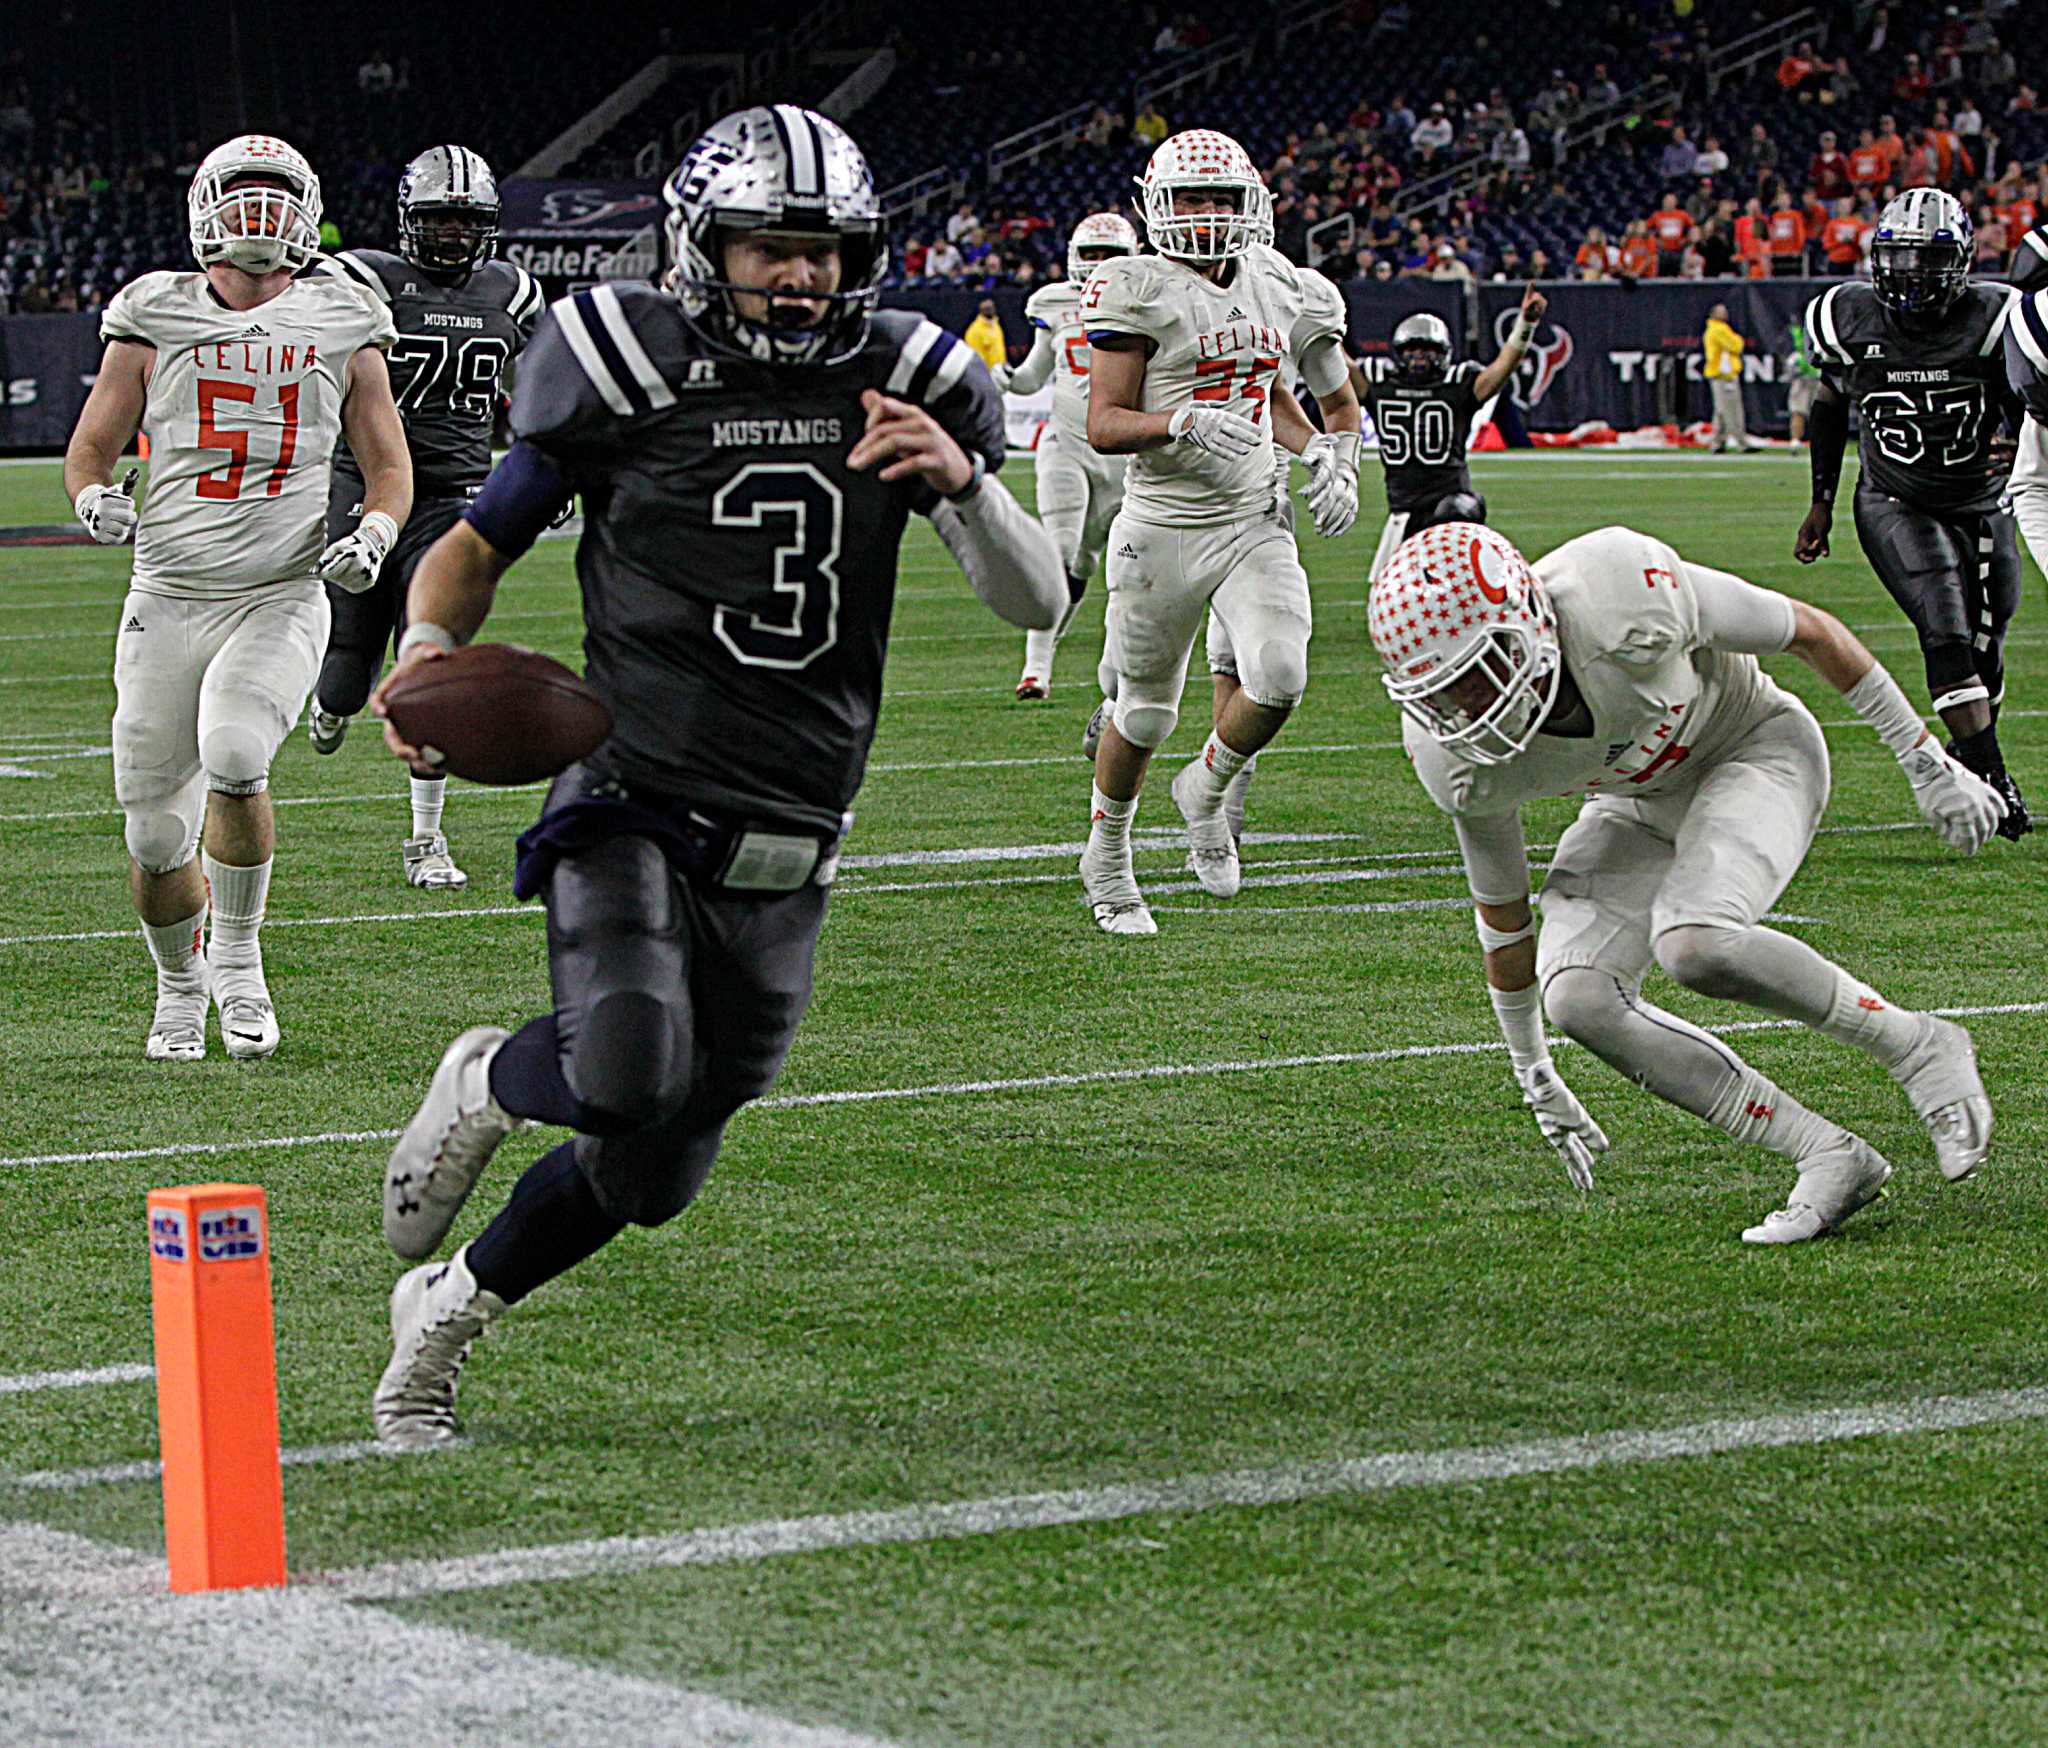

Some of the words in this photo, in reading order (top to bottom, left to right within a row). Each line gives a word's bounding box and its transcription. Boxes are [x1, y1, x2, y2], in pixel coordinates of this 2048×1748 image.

[423, 313, 484, 330] MUSTANGS
[1198, 324, 1283, 358] CELINA
[0, 378, 38, 405] S
[386, 332, 510, 423] 78
[1886, 369, 1951, 383] MUSTANGS
[195, 378, 301, 500] 51
[711, 418, 843, 448] MUSTANGS
[1377, 399, 1454, 466] 50
[1859, 383, 1987, 467] 67
[711, 462, 844, 670] 3
